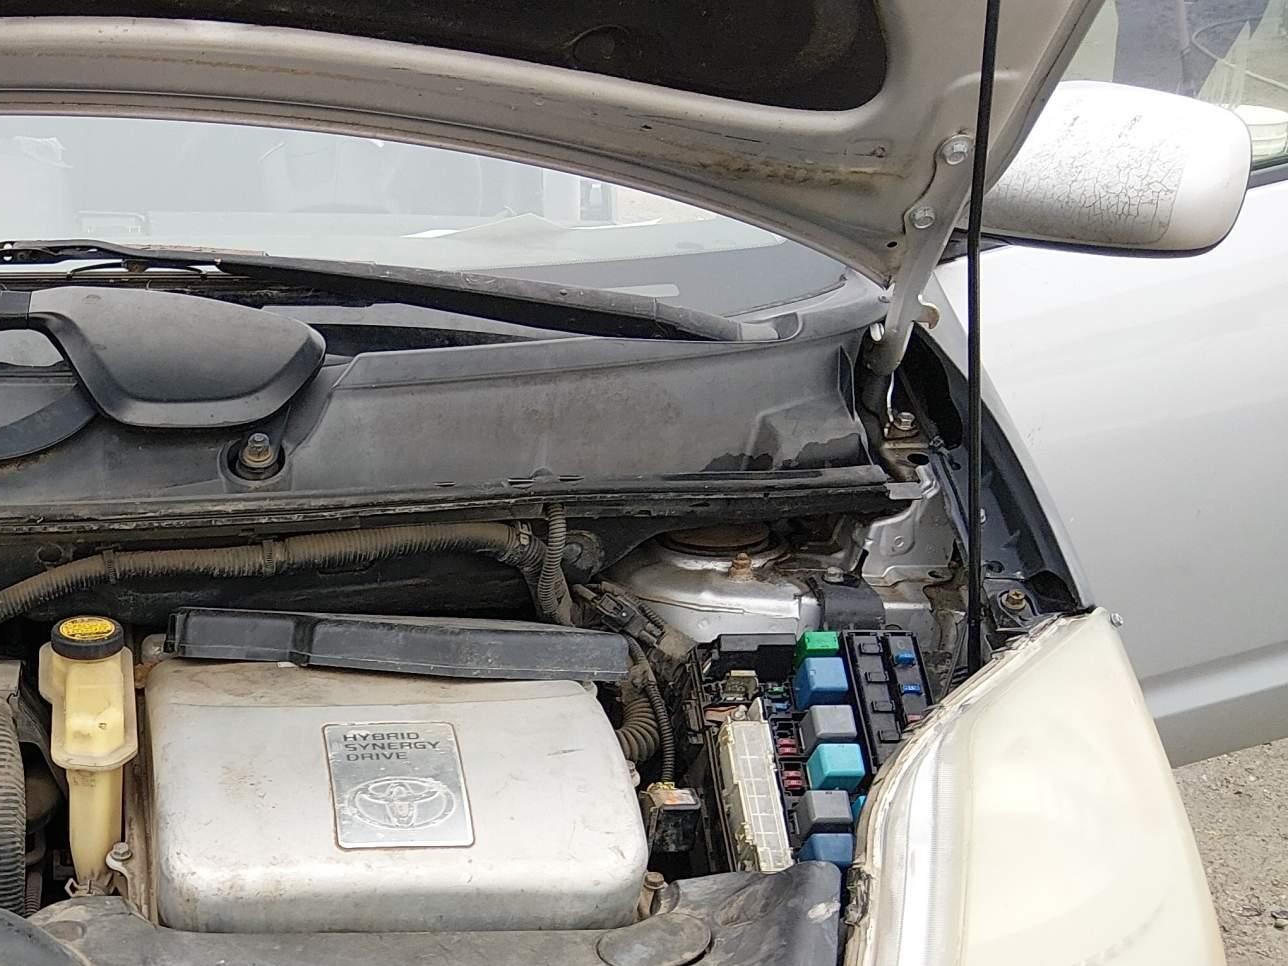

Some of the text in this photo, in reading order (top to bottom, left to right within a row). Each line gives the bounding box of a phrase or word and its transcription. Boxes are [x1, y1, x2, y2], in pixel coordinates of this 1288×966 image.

[343, 732, 420, 741] HYBRID
[344, 741, 440, 752] SYNERGY
[346, 751, 408, 762] DRIVE
